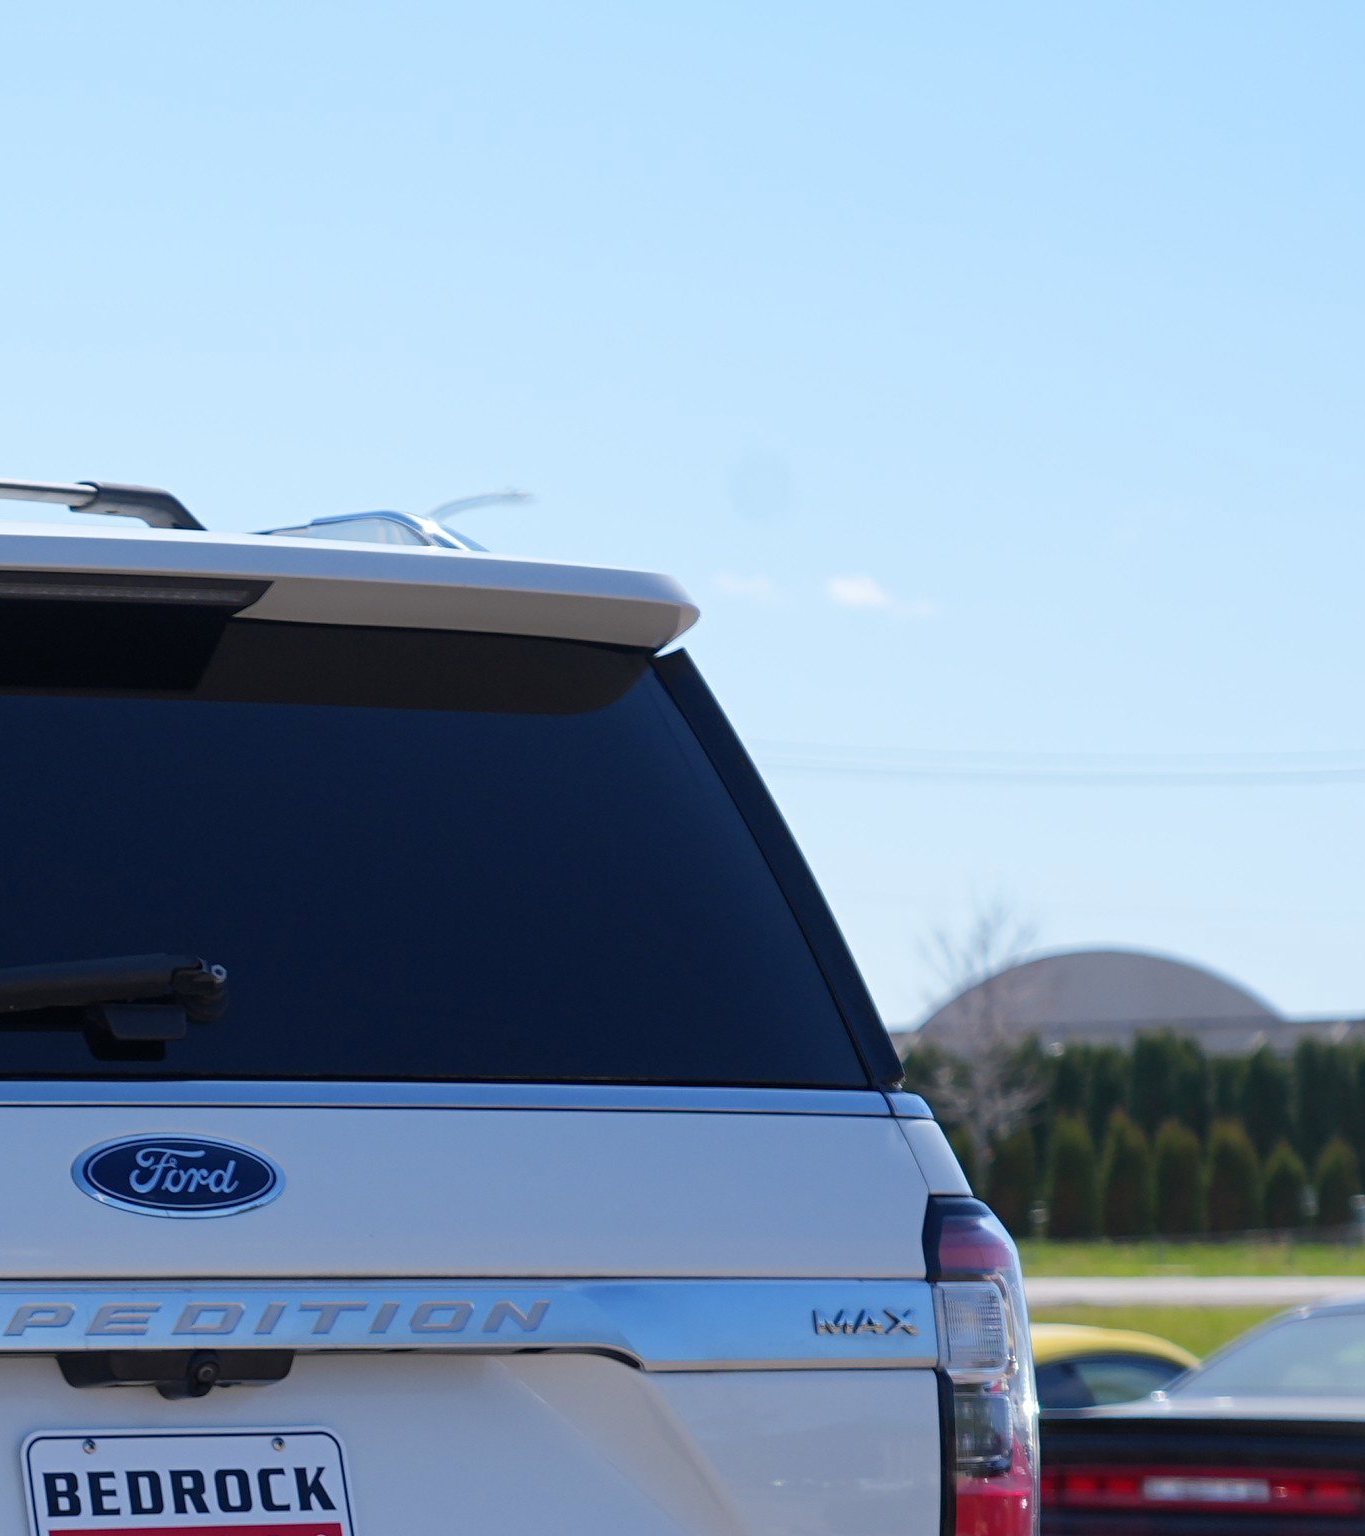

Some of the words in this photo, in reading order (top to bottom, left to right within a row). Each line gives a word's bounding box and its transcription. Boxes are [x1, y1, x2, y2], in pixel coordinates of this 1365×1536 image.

[128, 1147, 239, 1194] Ford
[811, 1308, 918, 1336] MAX
[42, 1466, 337, 1517] BEDROCK
